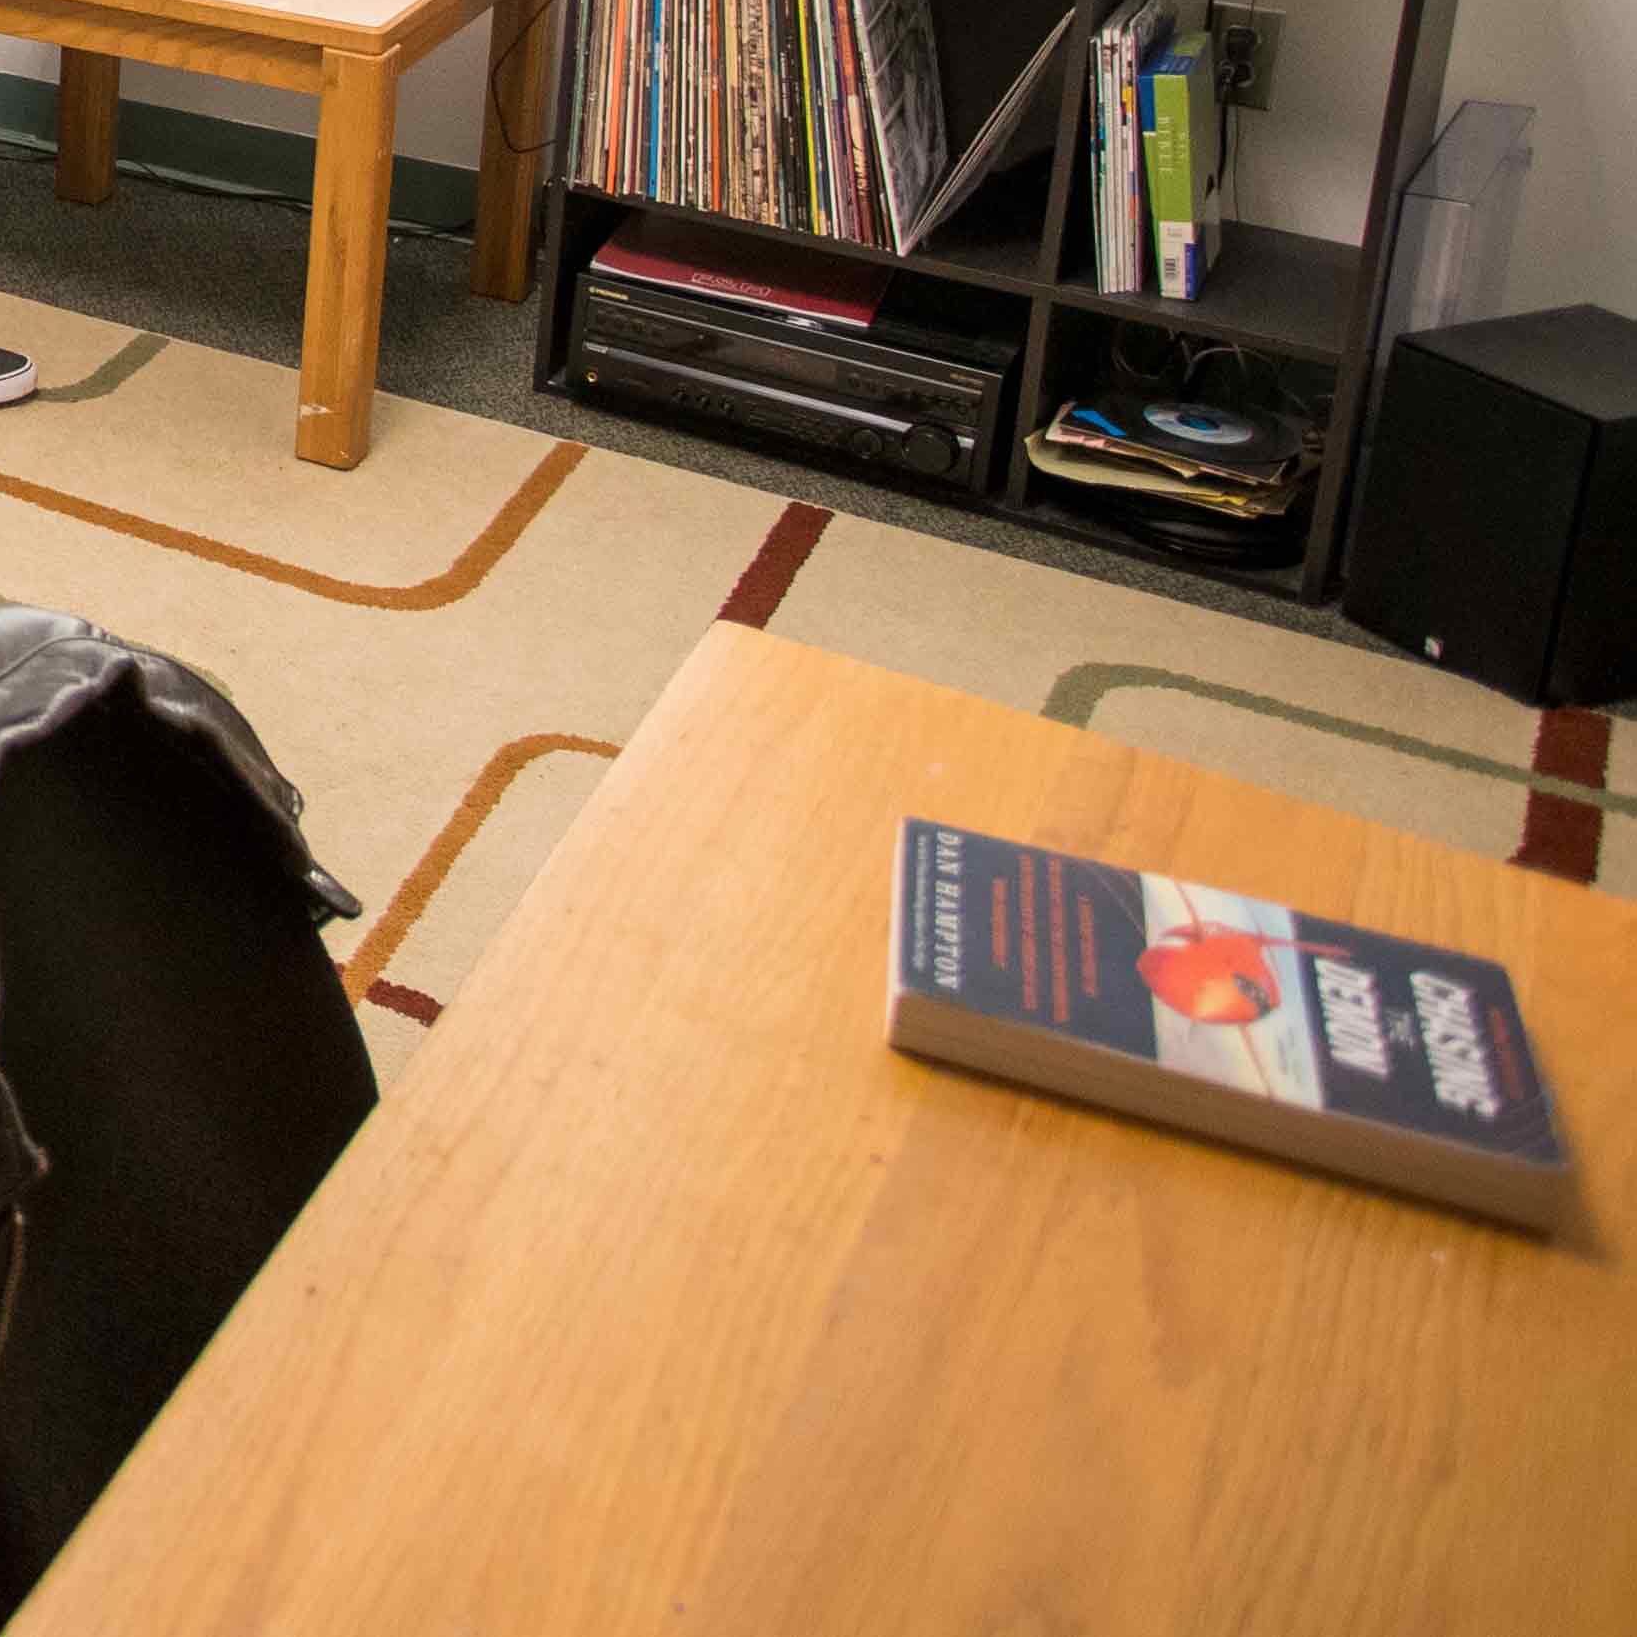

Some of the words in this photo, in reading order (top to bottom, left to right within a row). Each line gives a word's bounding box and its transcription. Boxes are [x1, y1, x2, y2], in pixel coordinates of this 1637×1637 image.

[935, 831, 962, 876] DAN
[933, 879, 962, 990] HAMPTON
[1314, 956, 1390, 1082] DEMON
[1408, 968, 1504, 1120] CHASING
